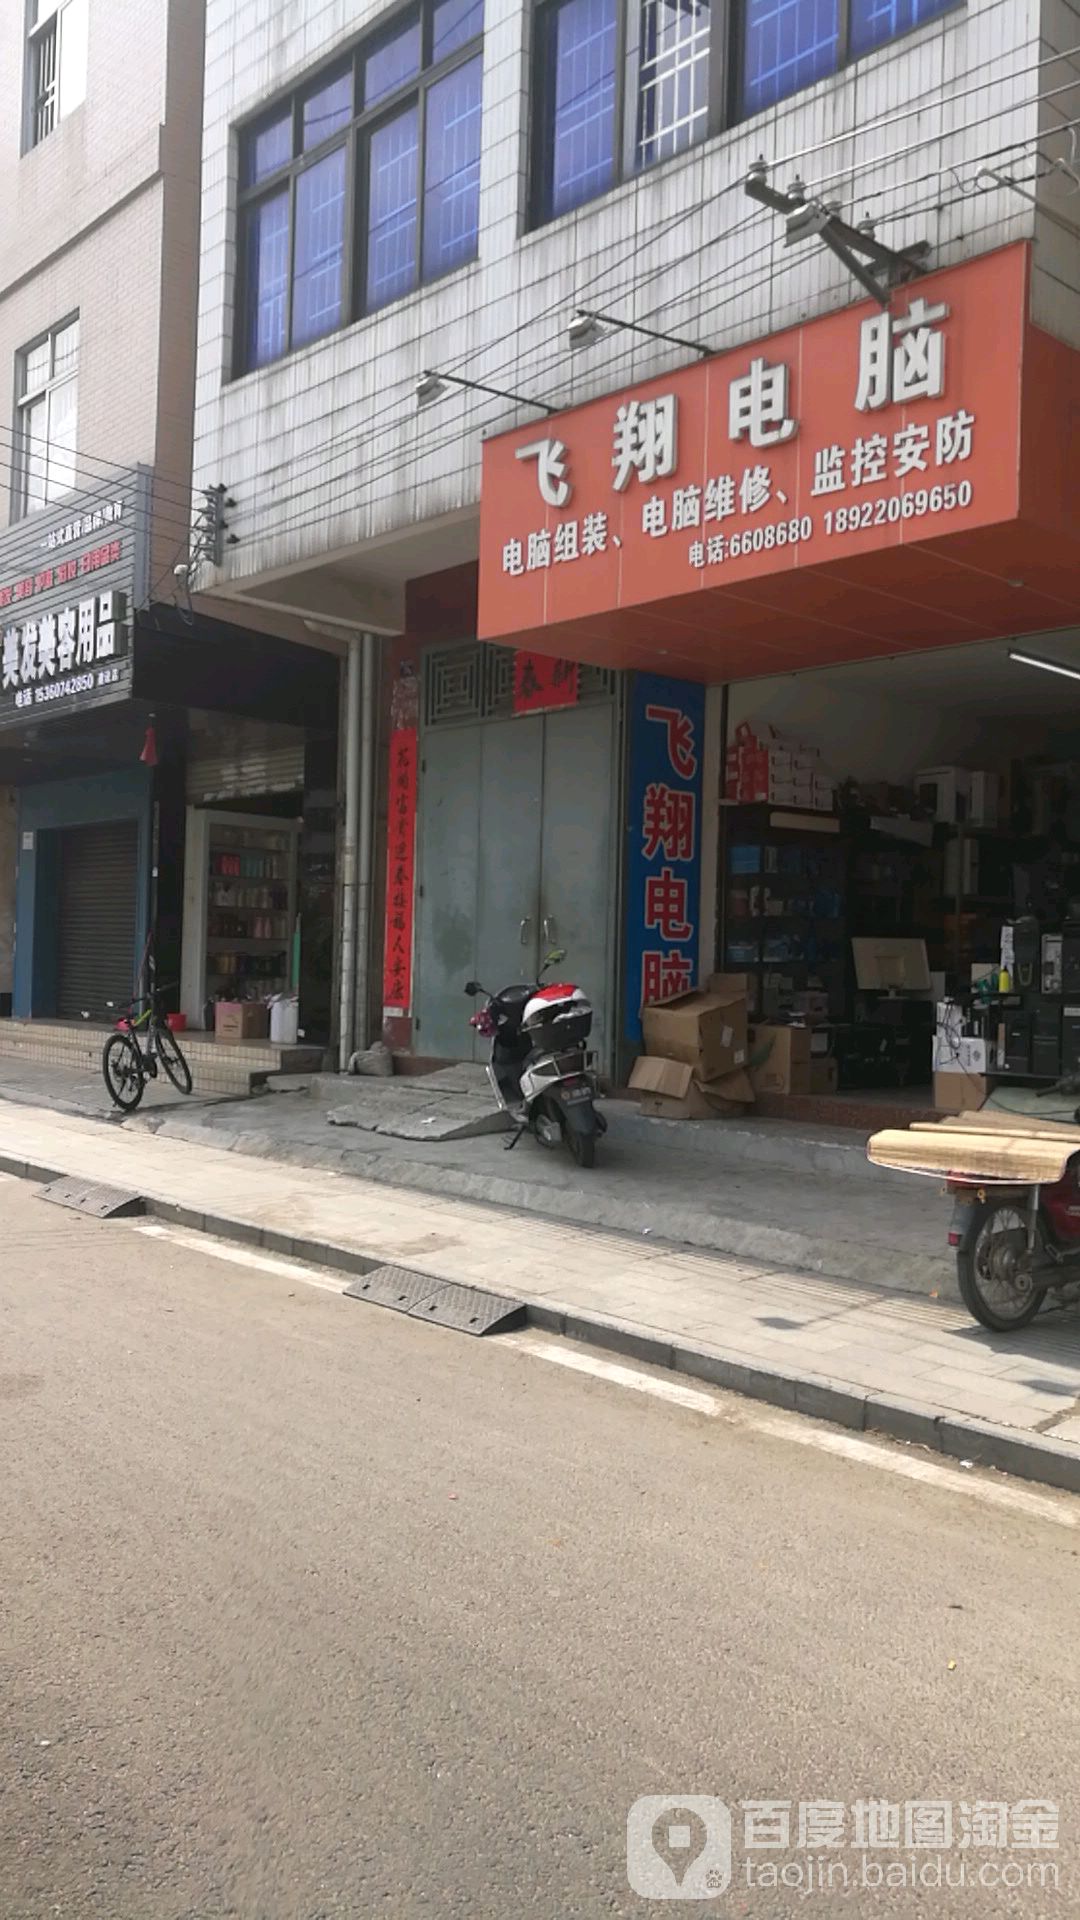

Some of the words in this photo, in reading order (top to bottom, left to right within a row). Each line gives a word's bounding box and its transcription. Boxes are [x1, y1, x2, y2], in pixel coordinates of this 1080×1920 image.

[516, 297, 951, 508] 飞翔电脑
[823, 480, 973, 537] 18922069650
[2, 591, 115, 690] 美发美容用品
[642, 704, 698, 1005] 飞翔电脑
